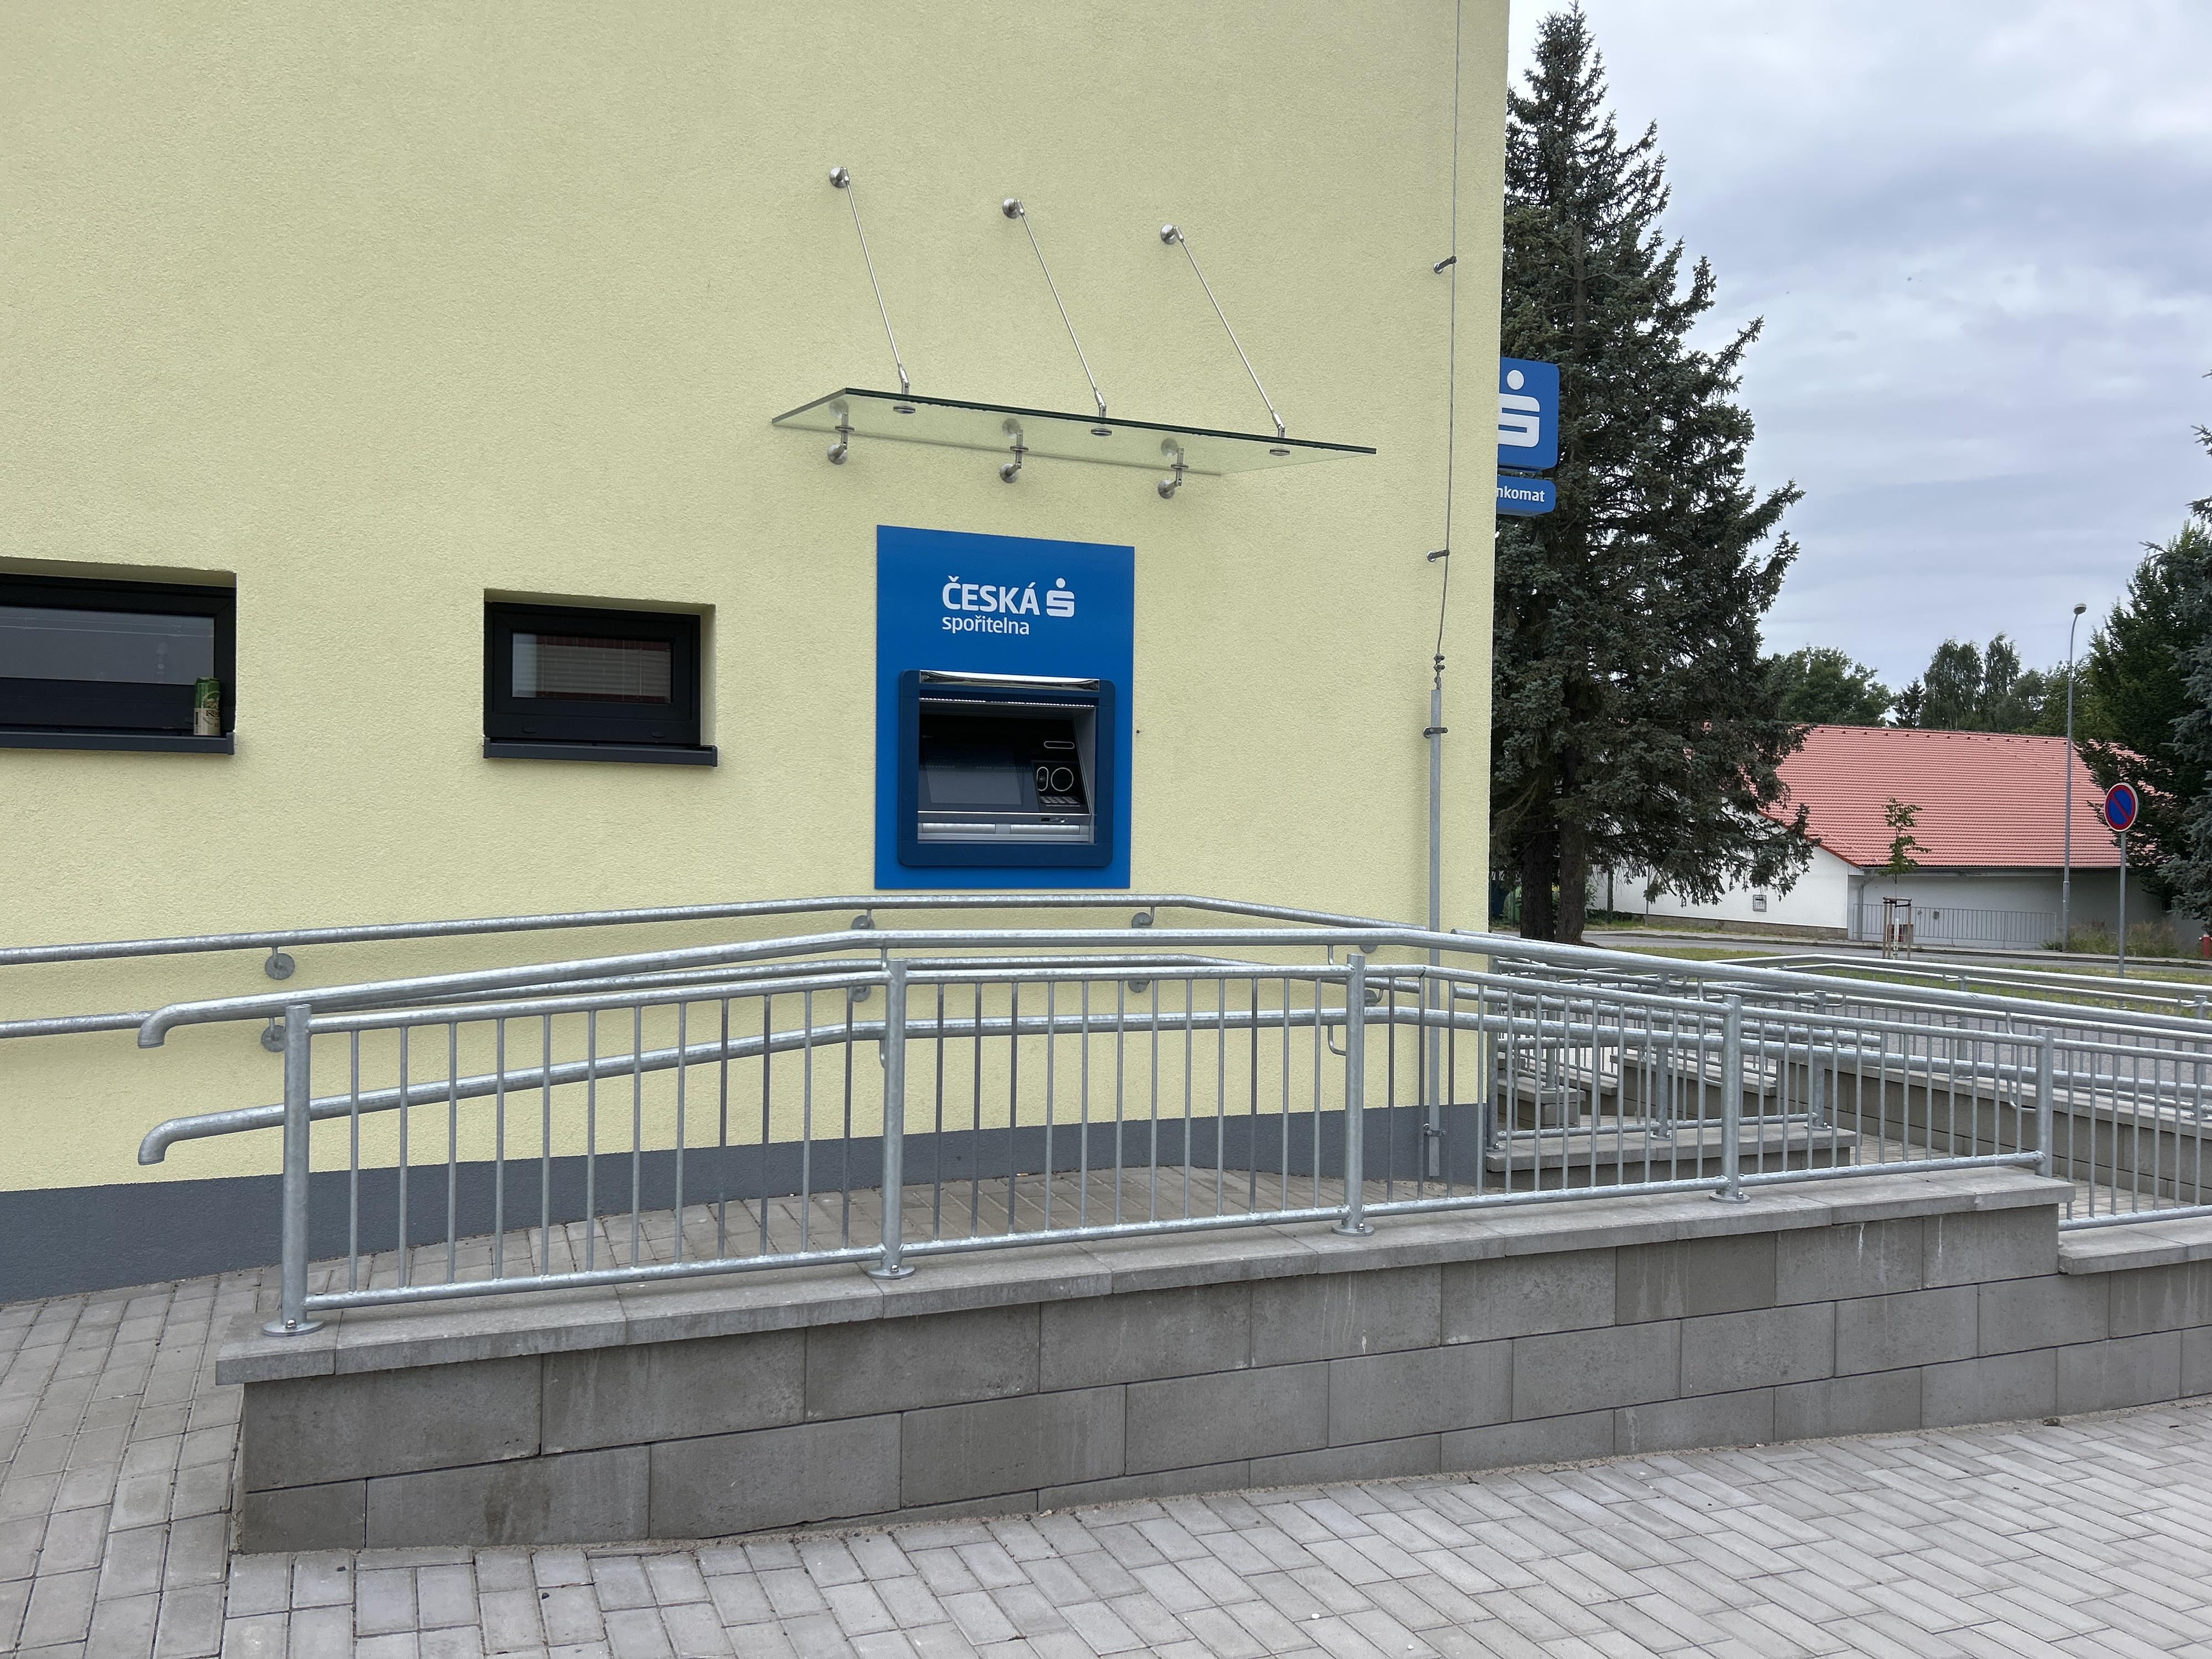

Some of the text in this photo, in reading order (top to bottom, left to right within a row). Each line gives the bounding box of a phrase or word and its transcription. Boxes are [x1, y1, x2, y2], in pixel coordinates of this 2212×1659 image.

[1496, 486, 1546, 502] nkomat
[942, 575, 1040, 615] ČESKÁ
[942, 614, 1030, 635] spořitelna
